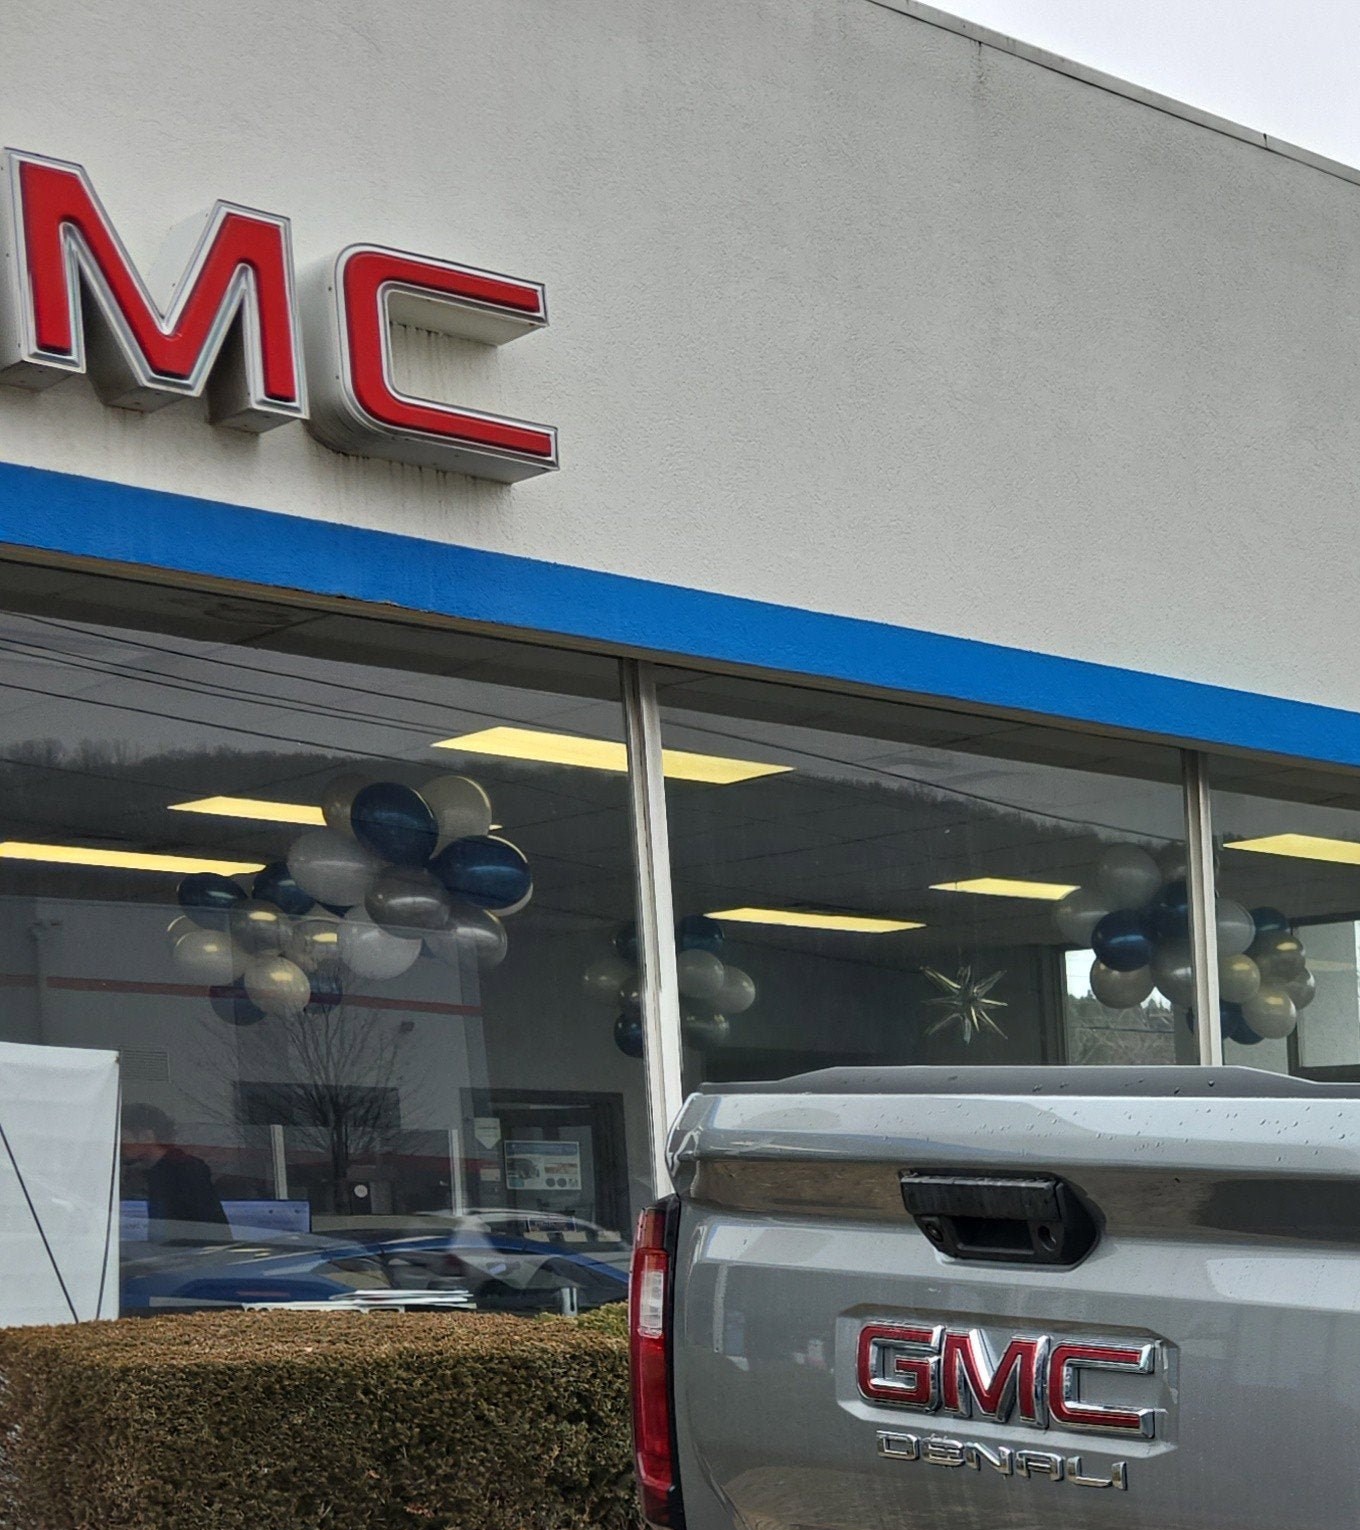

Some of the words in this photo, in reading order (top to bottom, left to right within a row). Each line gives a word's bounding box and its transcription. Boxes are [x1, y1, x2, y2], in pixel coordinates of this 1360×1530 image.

[1, 147, 560, 474] MC
[856, 1321, 1157, 1439] GMC
[876, 1430, 1129, 1491] DENALI
